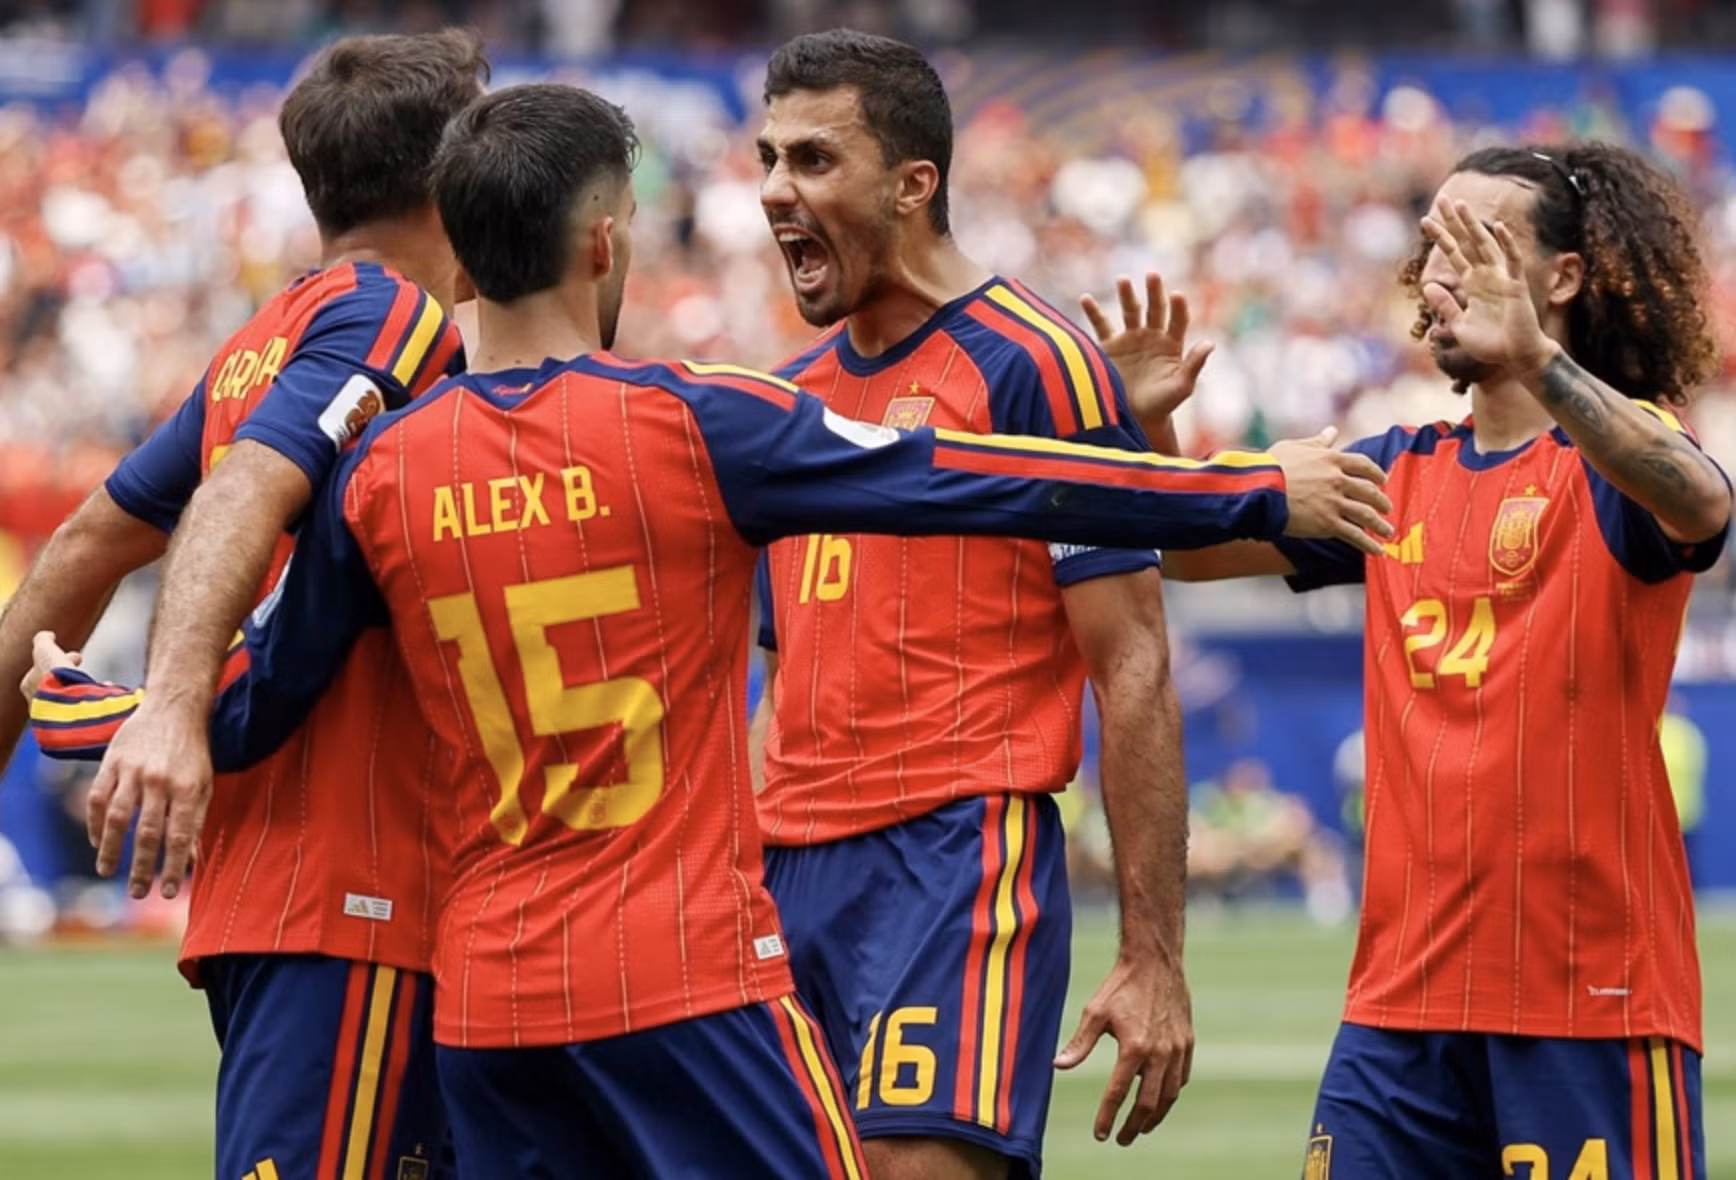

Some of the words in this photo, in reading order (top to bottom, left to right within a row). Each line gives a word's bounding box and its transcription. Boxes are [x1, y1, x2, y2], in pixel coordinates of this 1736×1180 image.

[432, 473, 551, 541] ALEX
[561, 466, 610, 521] B.
[799, 534, 852, 605] 16
[1401, 598, 1496, 688] 24
[427, 564, 664, 846] 15
[856, 1006, 938, 1111] 16
